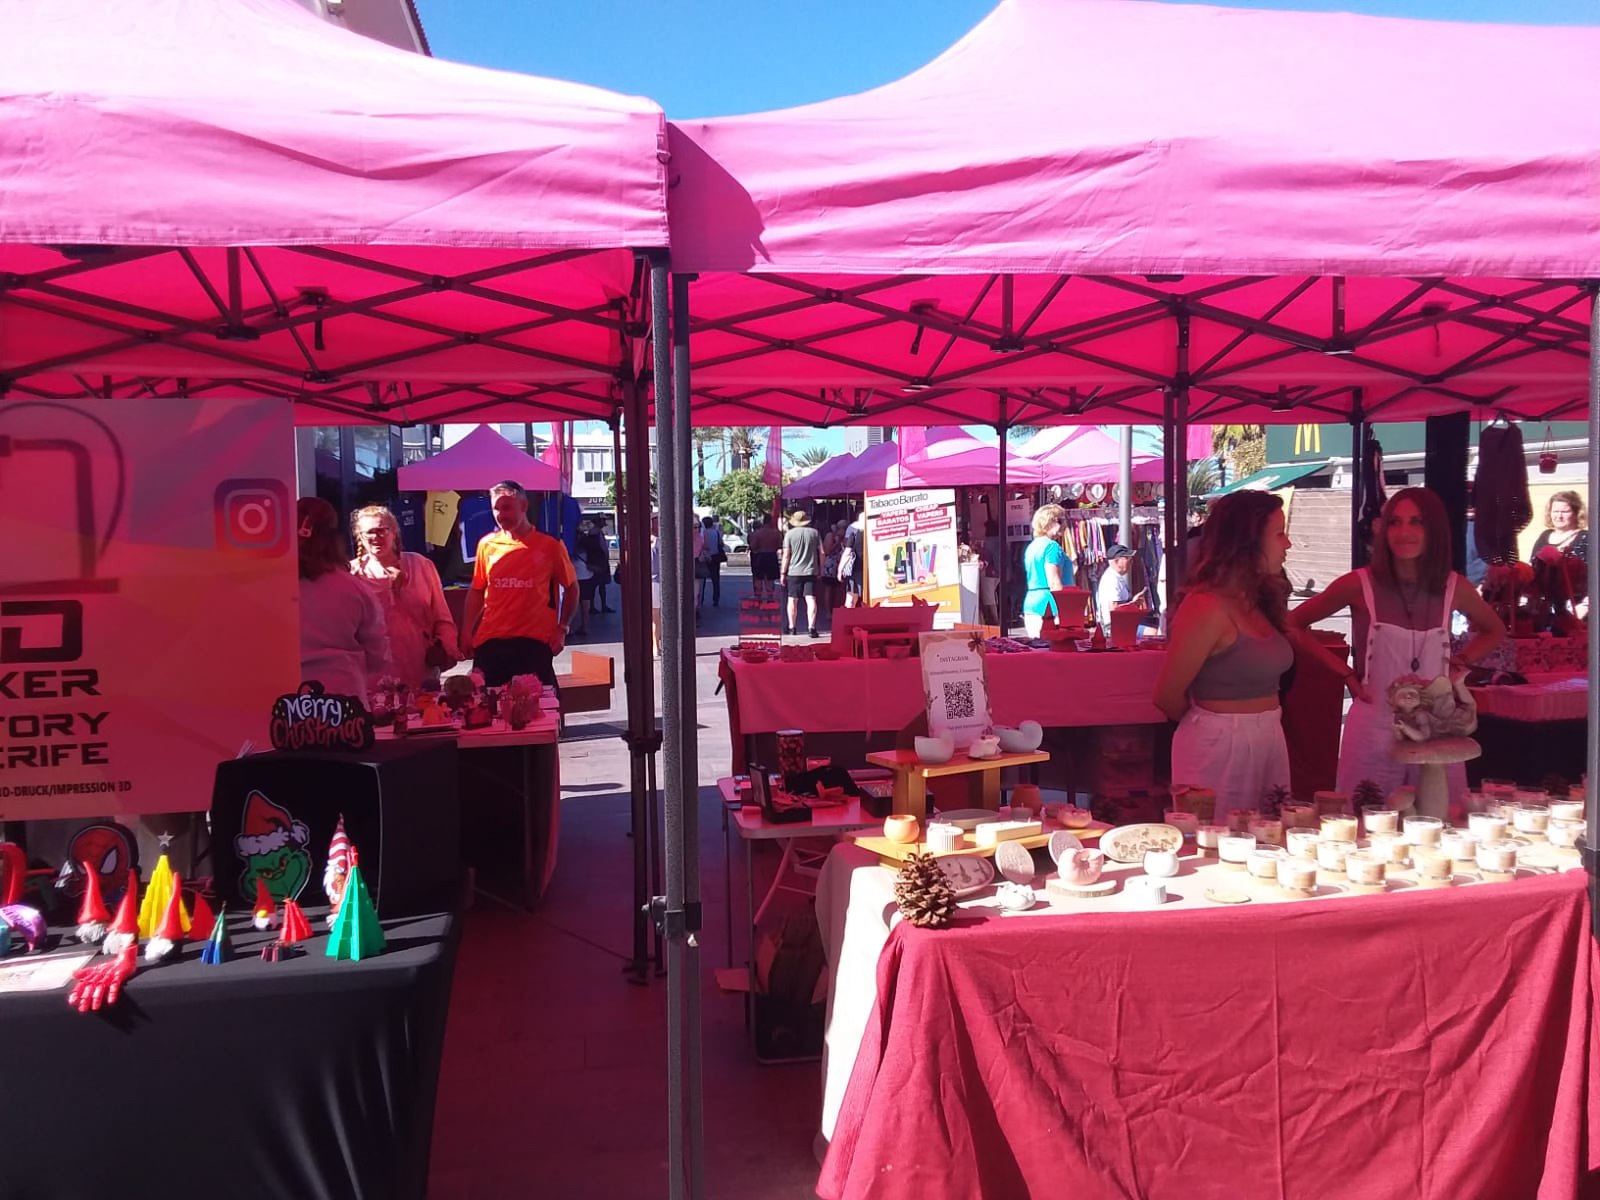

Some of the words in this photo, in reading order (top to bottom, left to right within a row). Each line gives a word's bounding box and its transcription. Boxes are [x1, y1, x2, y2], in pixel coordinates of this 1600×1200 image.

[882, 510, 907, 518] VAPERS
[917, 510, 943, 519] VAPERS
[878, 516, 909, 526] BARATOS
[494, 578, 533, 588] 32Red
[283, 695, 342, 727] Merry
[0, 712, 110, 738] ORY
[273, 717, 365, 749] Christmas
[0, 742, 109, 768] RIFE
[118, 781, 131, 791] 3D
